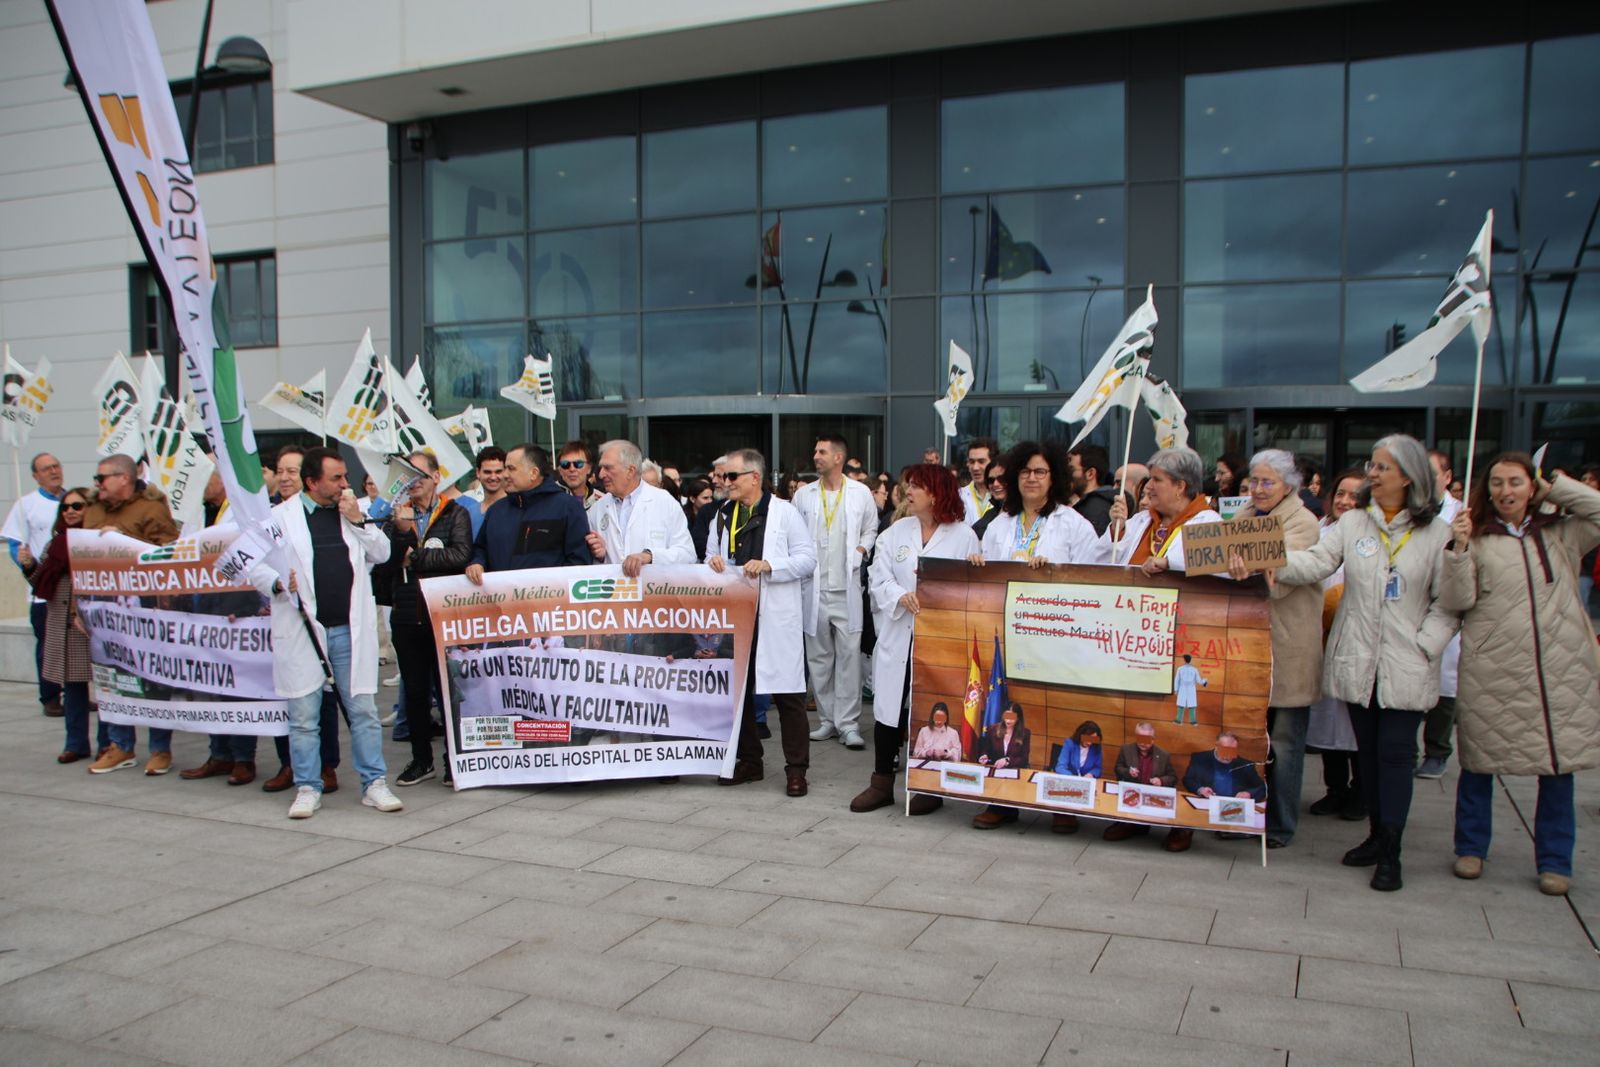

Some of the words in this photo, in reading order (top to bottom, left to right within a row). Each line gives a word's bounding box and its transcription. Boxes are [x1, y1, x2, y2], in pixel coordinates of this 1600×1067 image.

[1187, 524, 1220, 540] HORA
[1222, 517, 1281, 537] TRABAJADA
[1187, 545, 1224, 568] HORA
[73, 569, 118, 591] HUELGA
[119, 566, 182, 591] MÉDICA
[572, 577, 638, 601] CESM
[644, 582, 724, 597] Salamanca
[443, 592, 506, 608] Sindicato
[512, 585, 565, 602] Médico
[1016, 593, 1068, 607] Acuerdo
[1073, 597, 1100, 611] para
[442, 614, 528, 641] HUELGA
[533, 606, 619, 633] MÉDICA
[623, 607, 735, 630] NACIONAL
[1014, 610, 1029, 620] un
[1034, 611, 1071, 623] nuevo
[1142, 617, 1161, 633] DE
[105, 610, 156, 640] ESTATUTO
[159, 620, 176, 644] DE
[179, 621, 197, 647] LA
[1015, 622, 1065, 638] Estatuto
[138, 649, 146, 672] Y
[149, 652, 236, 689] FACULTATIVA
[459, 658, 481, 680] OR
[483, 655, 505, 677] UN
[508, 655, 581, 682] ESTATUTO
[585, 659, 606, 684] DE
[609, 662, 630, 687] LA
[634, 664, 730, 696] PROFESIÓN
[176, 709, 220, 723] PRIMARIA
[221, 710, 235, 724] DE
[236, 710, 290, 725] SALAMAN
[501, 683, 548, 716] MÉDICA
[550, 694, 561, 718] Y
[565, 695, 670, 728] FACULTATIVA
[456, 755, 531, 775] MEDICO/AS
[534, 753, 559, 768] DEL
[562, 749, 631, 767] HOSPITAL
[634, 747, 653, 763] DE
[656, 745, 728, 761] SALAMAN
